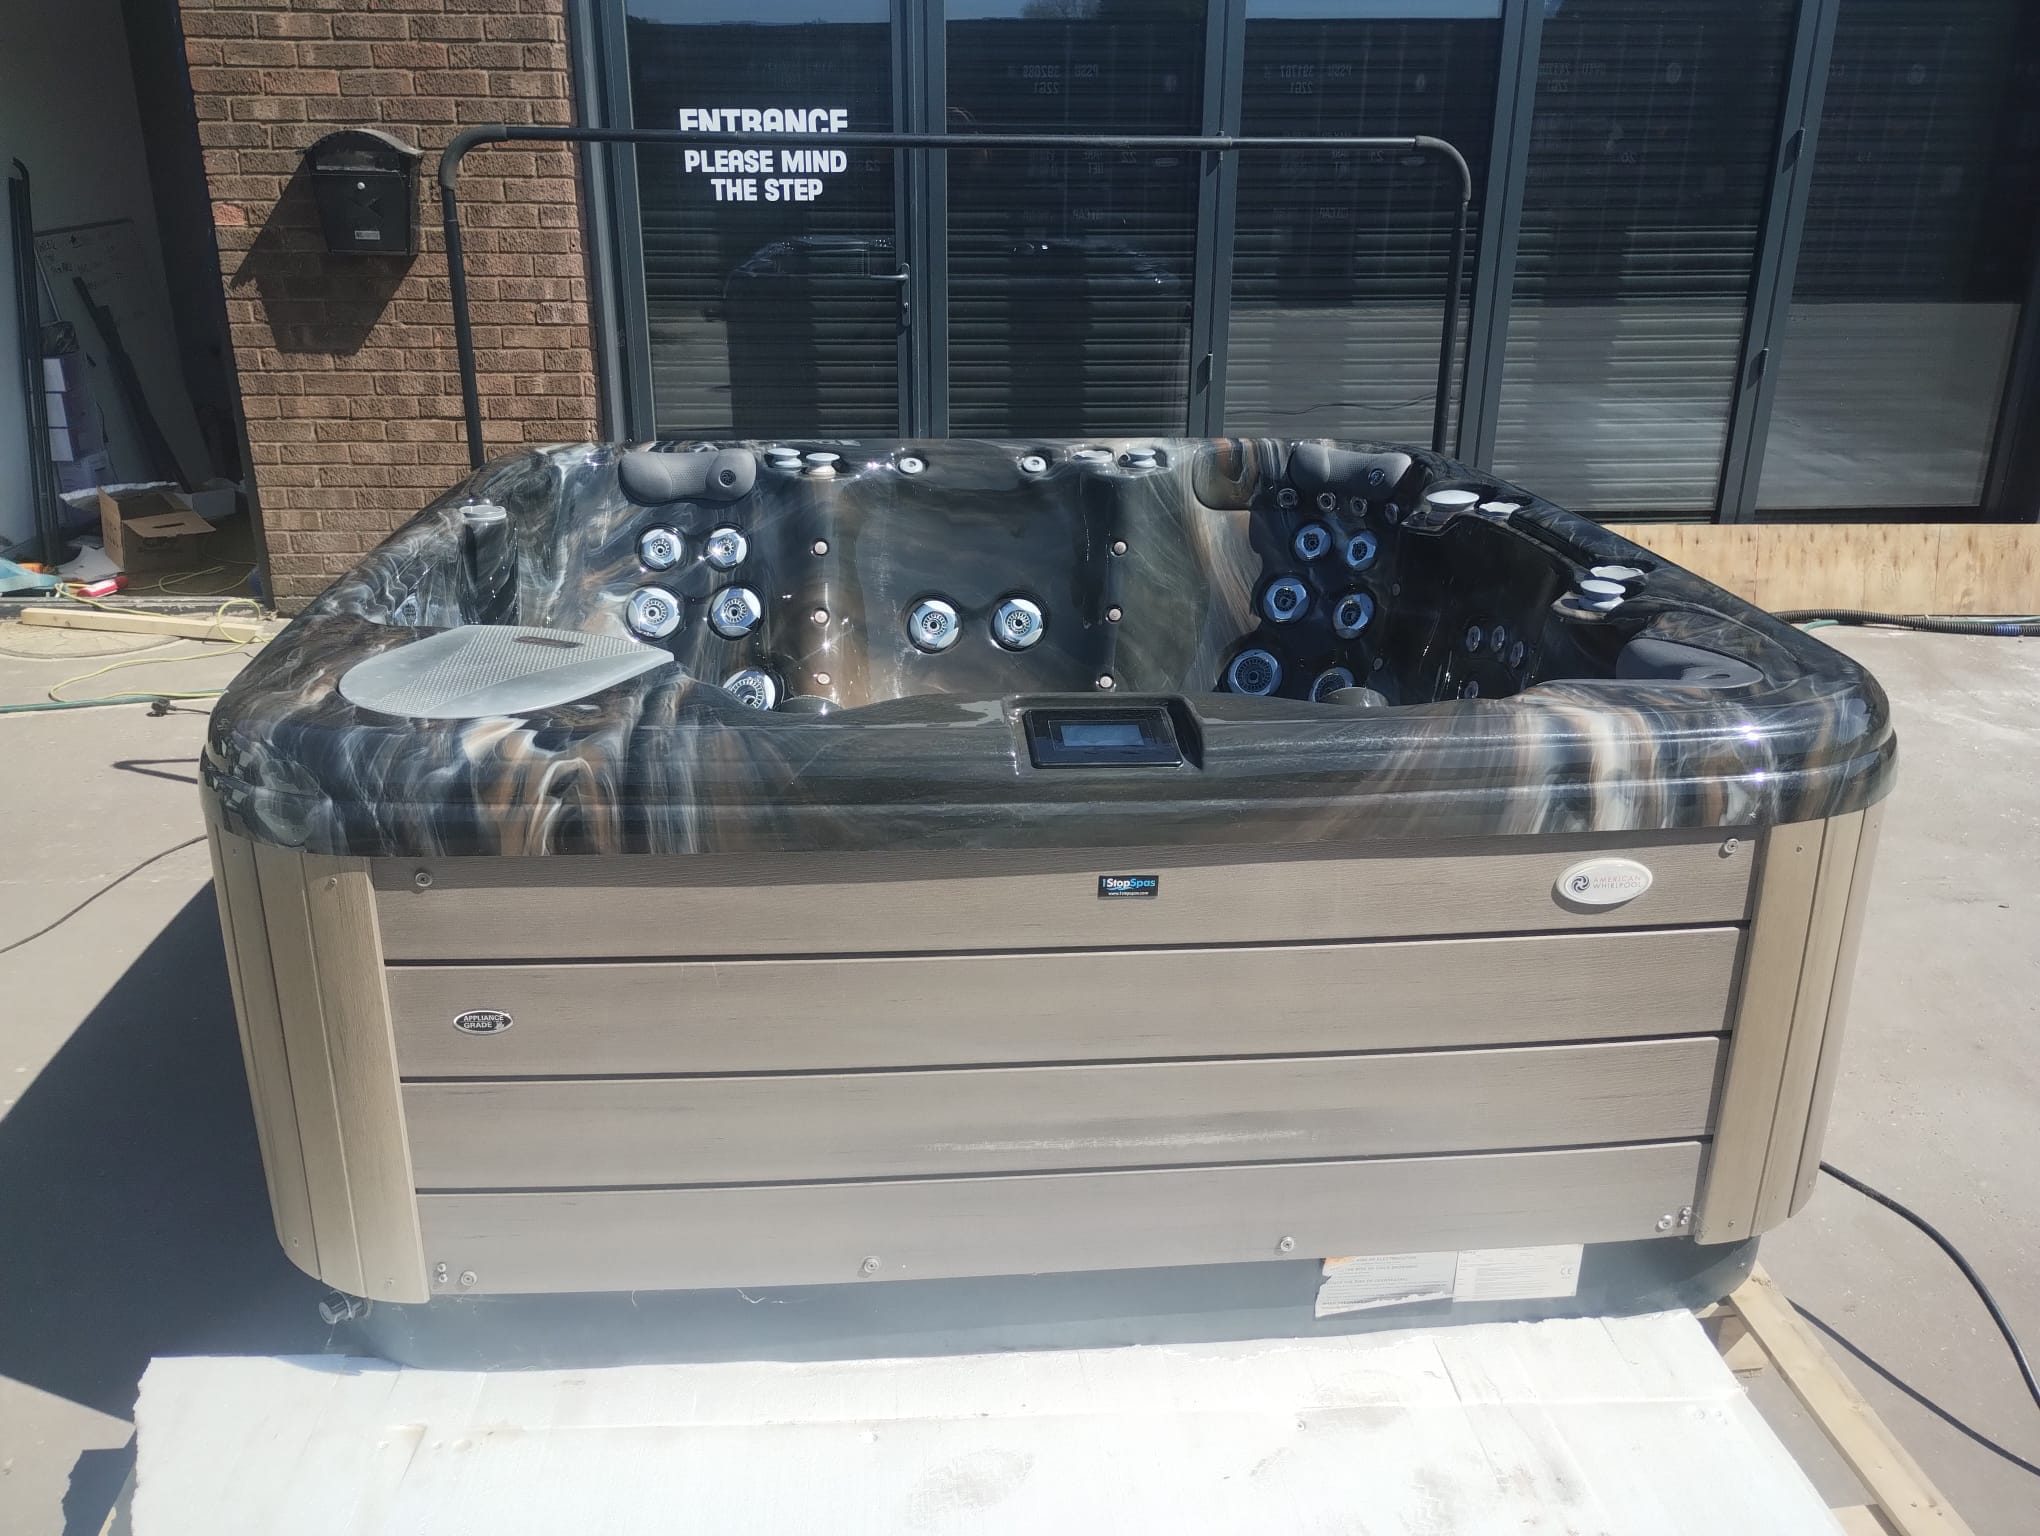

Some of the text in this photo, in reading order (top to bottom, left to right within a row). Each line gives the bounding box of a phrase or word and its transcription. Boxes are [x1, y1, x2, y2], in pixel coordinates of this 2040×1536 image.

[679, 108, 848, 133] ENTRANCE
[684, 150, 847, 173] PLEASE MIND
[711, 178, 823, 201] THE STEP
